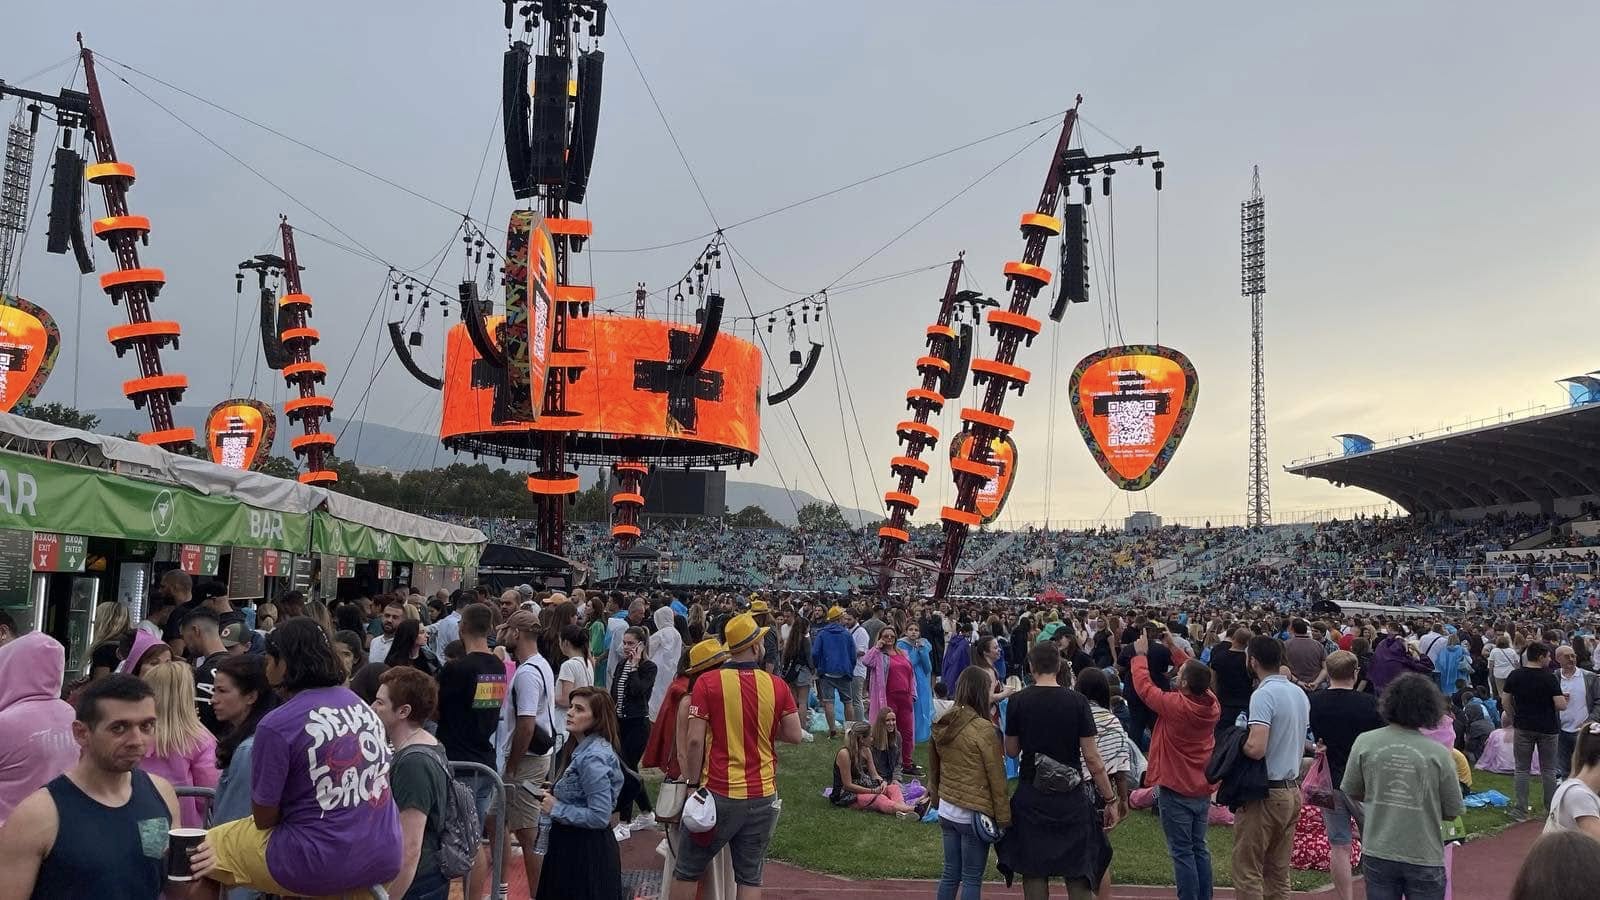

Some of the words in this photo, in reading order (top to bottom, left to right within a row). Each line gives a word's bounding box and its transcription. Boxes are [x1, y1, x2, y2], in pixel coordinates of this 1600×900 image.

[250, 510, 284, 541] BAR
[33, 533, 58, 544] ИЗХОД
[65, 535, 83, 545] ВХОД
[38, 544, 51, 552] EXIT
[64, 545, 83, 554] ENTER
[316, 762, 391, 812] BACK
